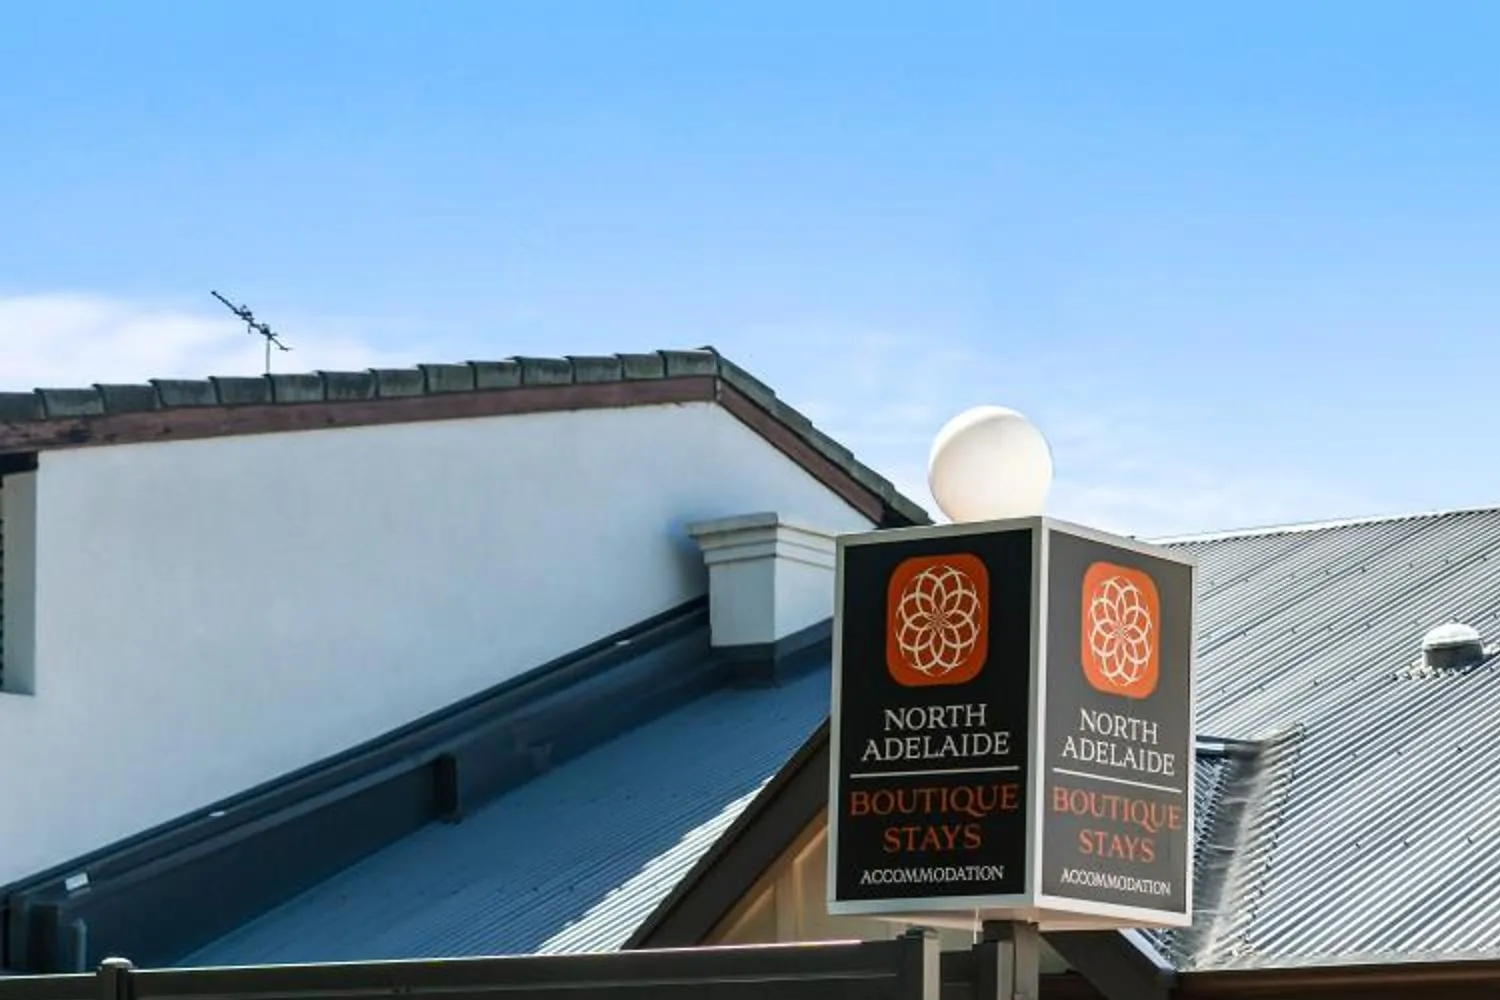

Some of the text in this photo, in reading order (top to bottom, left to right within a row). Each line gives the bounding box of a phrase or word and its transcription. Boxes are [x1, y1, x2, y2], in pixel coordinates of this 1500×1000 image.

[884, 703, 987, 731] NORTH
[1079, 707, 1159, 744] NORTH
[861, 732, 1010, 761] ADELAIDE
[1061, 735, 1175, 776] ADELAIDE
[849, 784, 1020, 818] BOUTIQUE
[1052, 785, 1183, 834] BOUTIQUE
[883, 823, 982, 853] STAYS
[1079, 829, 1156, 863] STAYS
[860, 865, 1005, 885] ACCOMMODATION
[1060, 867, 1171, 896] ACCOMMODATION
